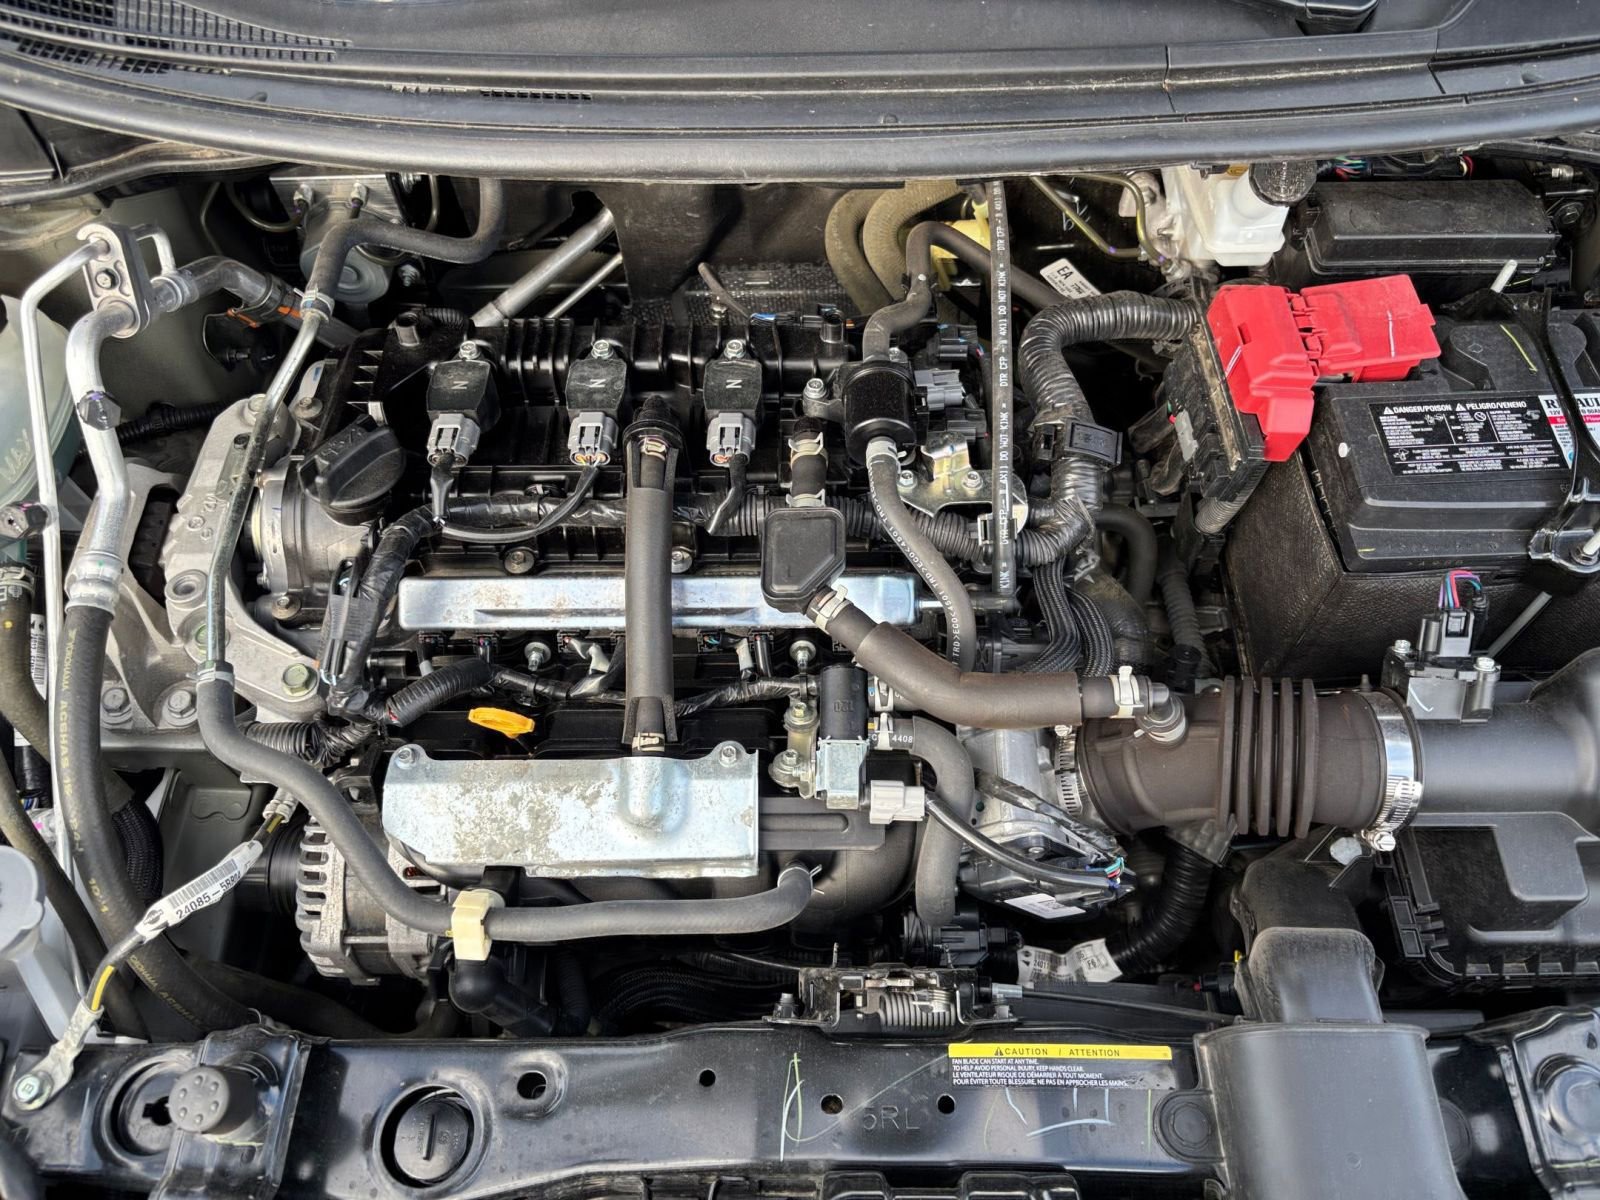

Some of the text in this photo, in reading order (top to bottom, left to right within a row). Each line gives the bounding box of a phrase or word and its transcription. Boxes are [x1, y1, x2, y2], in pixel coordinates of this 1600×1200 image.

[1057, 266, 1073, 280] EA
[1393, 404, 1453, 414] DANGER/POISON
[1465, 401, 1527, 410] PELIGRO/VENENO
[891, 735, 914, 743] 4408
[1004, 1048, 1048, 1056] CAUTION
[1069, 1048, 1120, 1057] ATTENTION
[1026, 1071, 1057, 1079] DÉMARRER
[970, 1077, 989, 1085] ÉVITER
[1008, 1078, 1036, 1086] BLESSURE,
